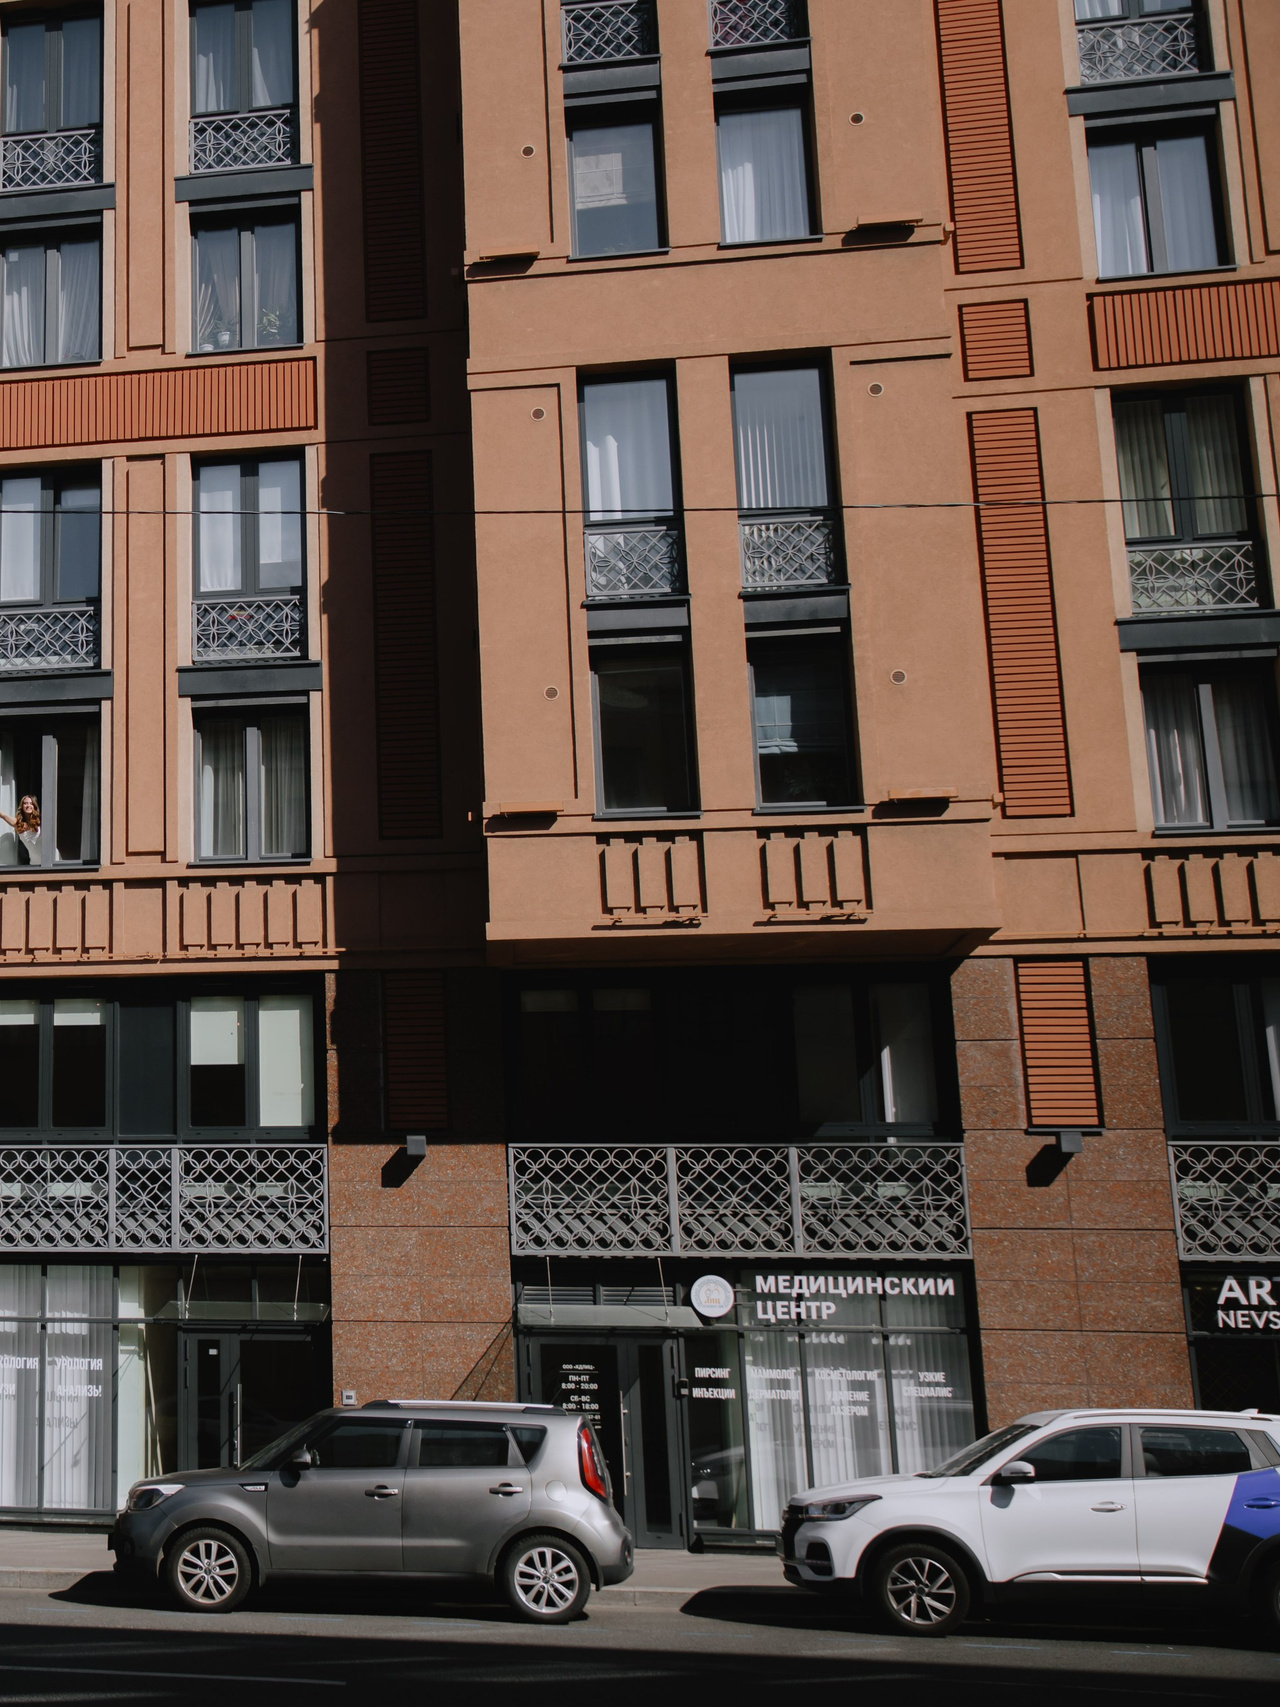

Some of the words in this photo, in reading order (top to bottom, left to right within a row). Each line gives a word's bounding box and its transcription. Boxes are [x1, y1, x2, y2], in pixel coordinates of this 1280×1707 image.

[756, 1300, 837, 1323] ЦЕНТР
[1217, 1310, 1280, 1329] NEVS
[55, 1358, 103, 1370] УРОЛОГИЯ
[694, 1367, 731, 1378] ПИРСИНГ
[750, 1368, 797, 1379] МАММОЛОГ
[814, 1368, 879, 1381] КОСМЕТОЛОГИЯ
[918, 1371, 947, 1383] УЗКИЕ
[692, 1388, 736, 1399] ИНЪЕКЦИИ
[747, 1389, 801, 1400] ДЕРМАТОЛОГ
[826, 1390, 870, 1402] УДАЛЕНИЕ
[903, 1386, 964, 1398] СПЕЦИАЛИС
[830, 1406, 869, 1417] ЛАЗЕРОМ
